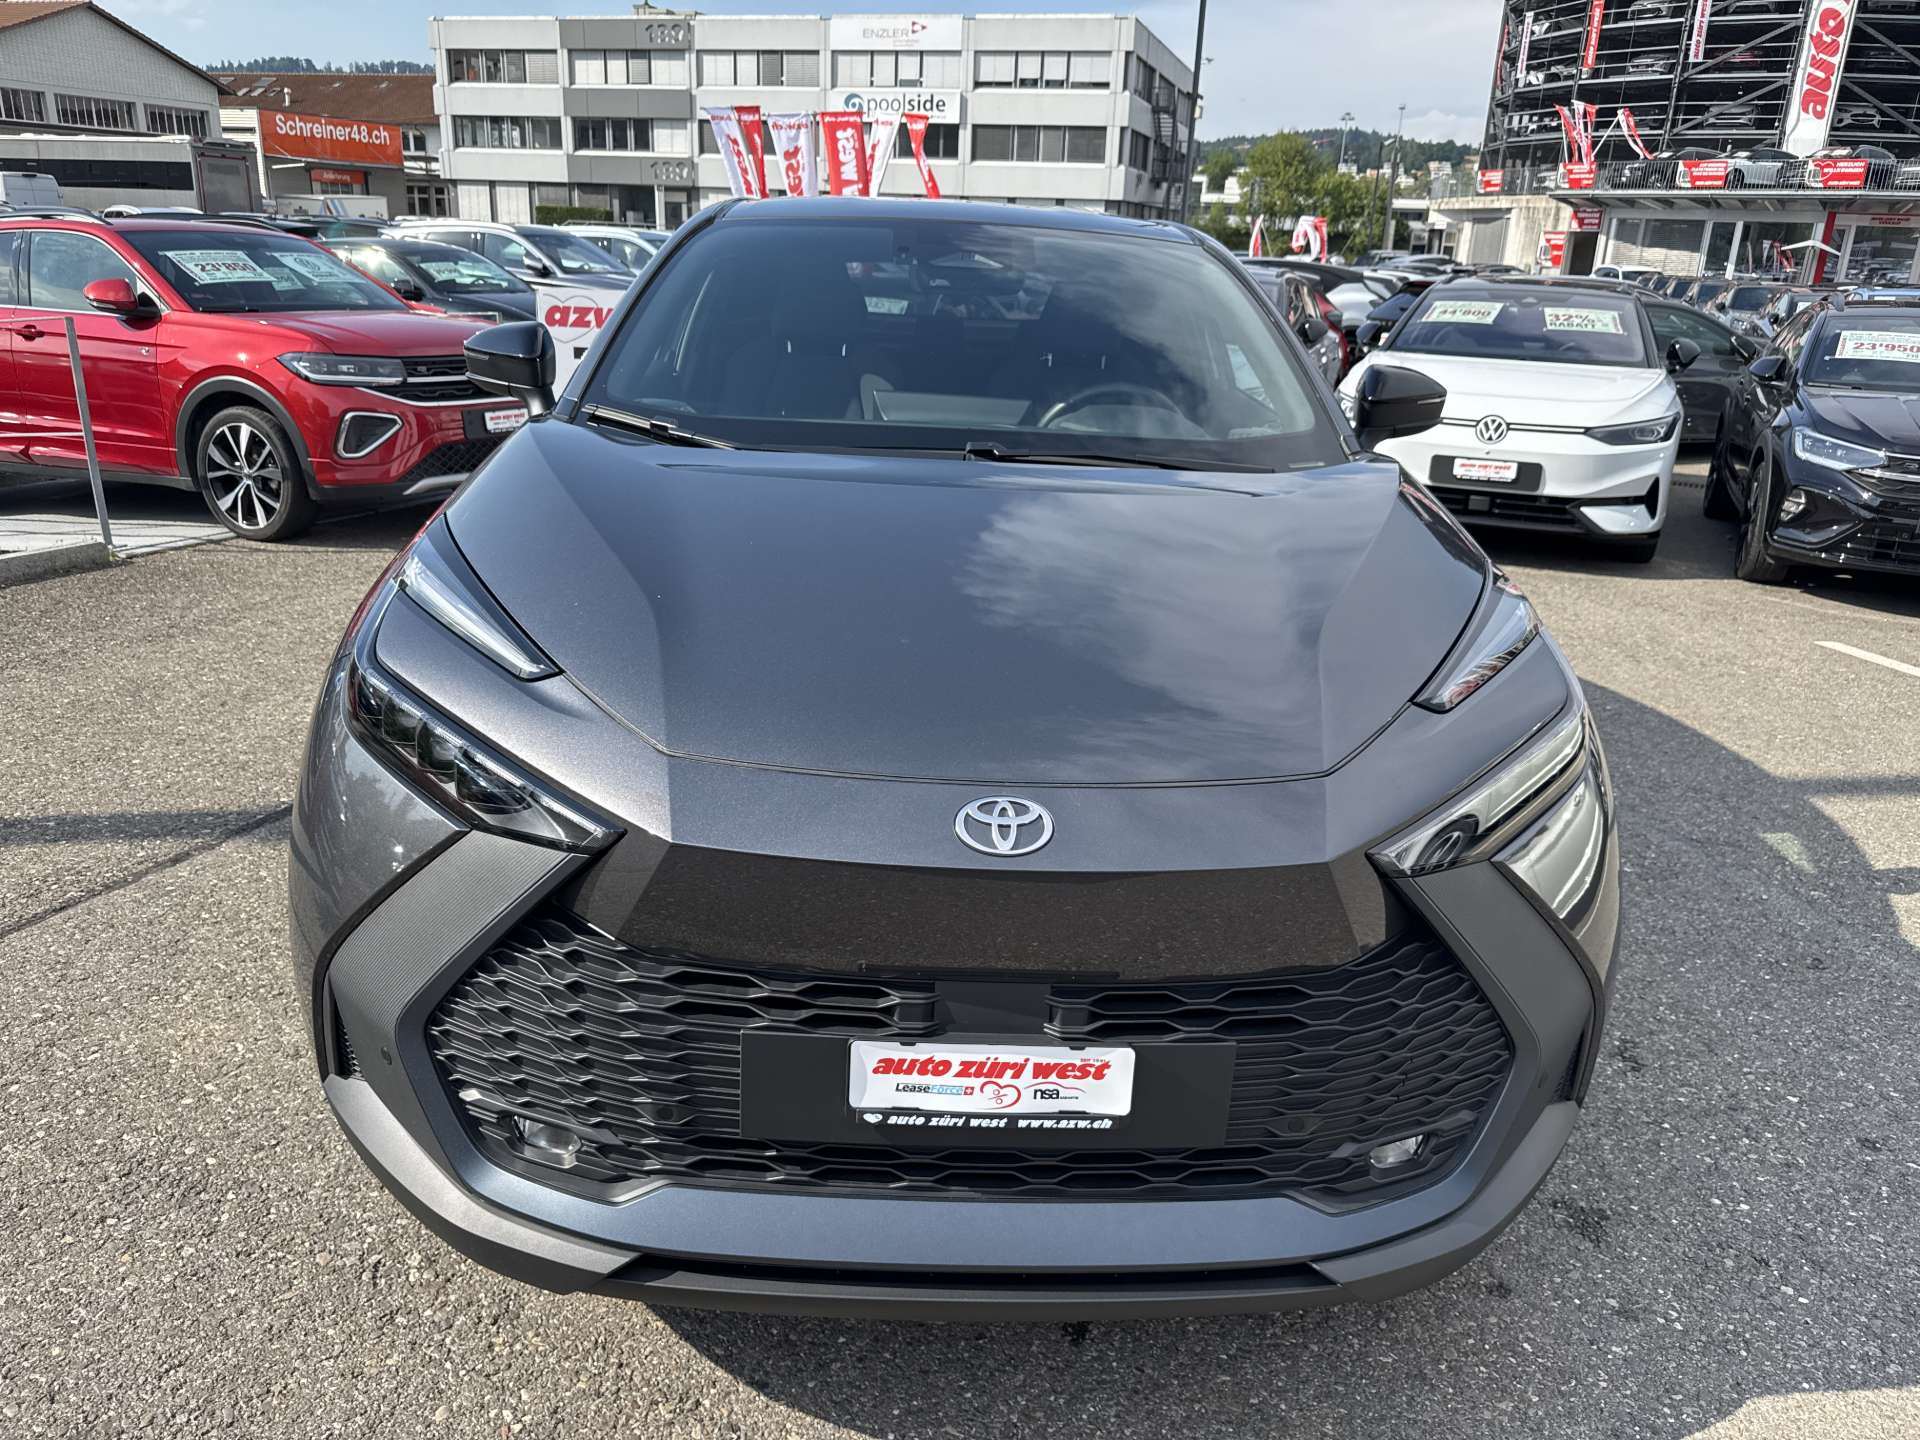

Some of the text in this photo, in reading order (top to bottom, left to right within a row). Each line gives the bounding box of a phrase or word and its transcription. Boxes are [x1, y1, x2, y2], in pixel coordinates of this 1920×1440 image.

[862, 28, 909, 39] ENZLER
[1801, 7, 1845, 120] auto
[867, 92, 946, 118] poolside
[275, 113, 390, 146] Schreiner48.ch
[1548, 313, 1596, 324] 32%
[1853, 342, 1920, 353] 23'950
[872, 1055, 1112, 1080] auto züri west
[895, 1083, 963, 1095] LeaseForce
[1033, 1088, 1060, 1100] nsa
[887, 1114, 1113, 1129] auto züri west www.azw.ch
